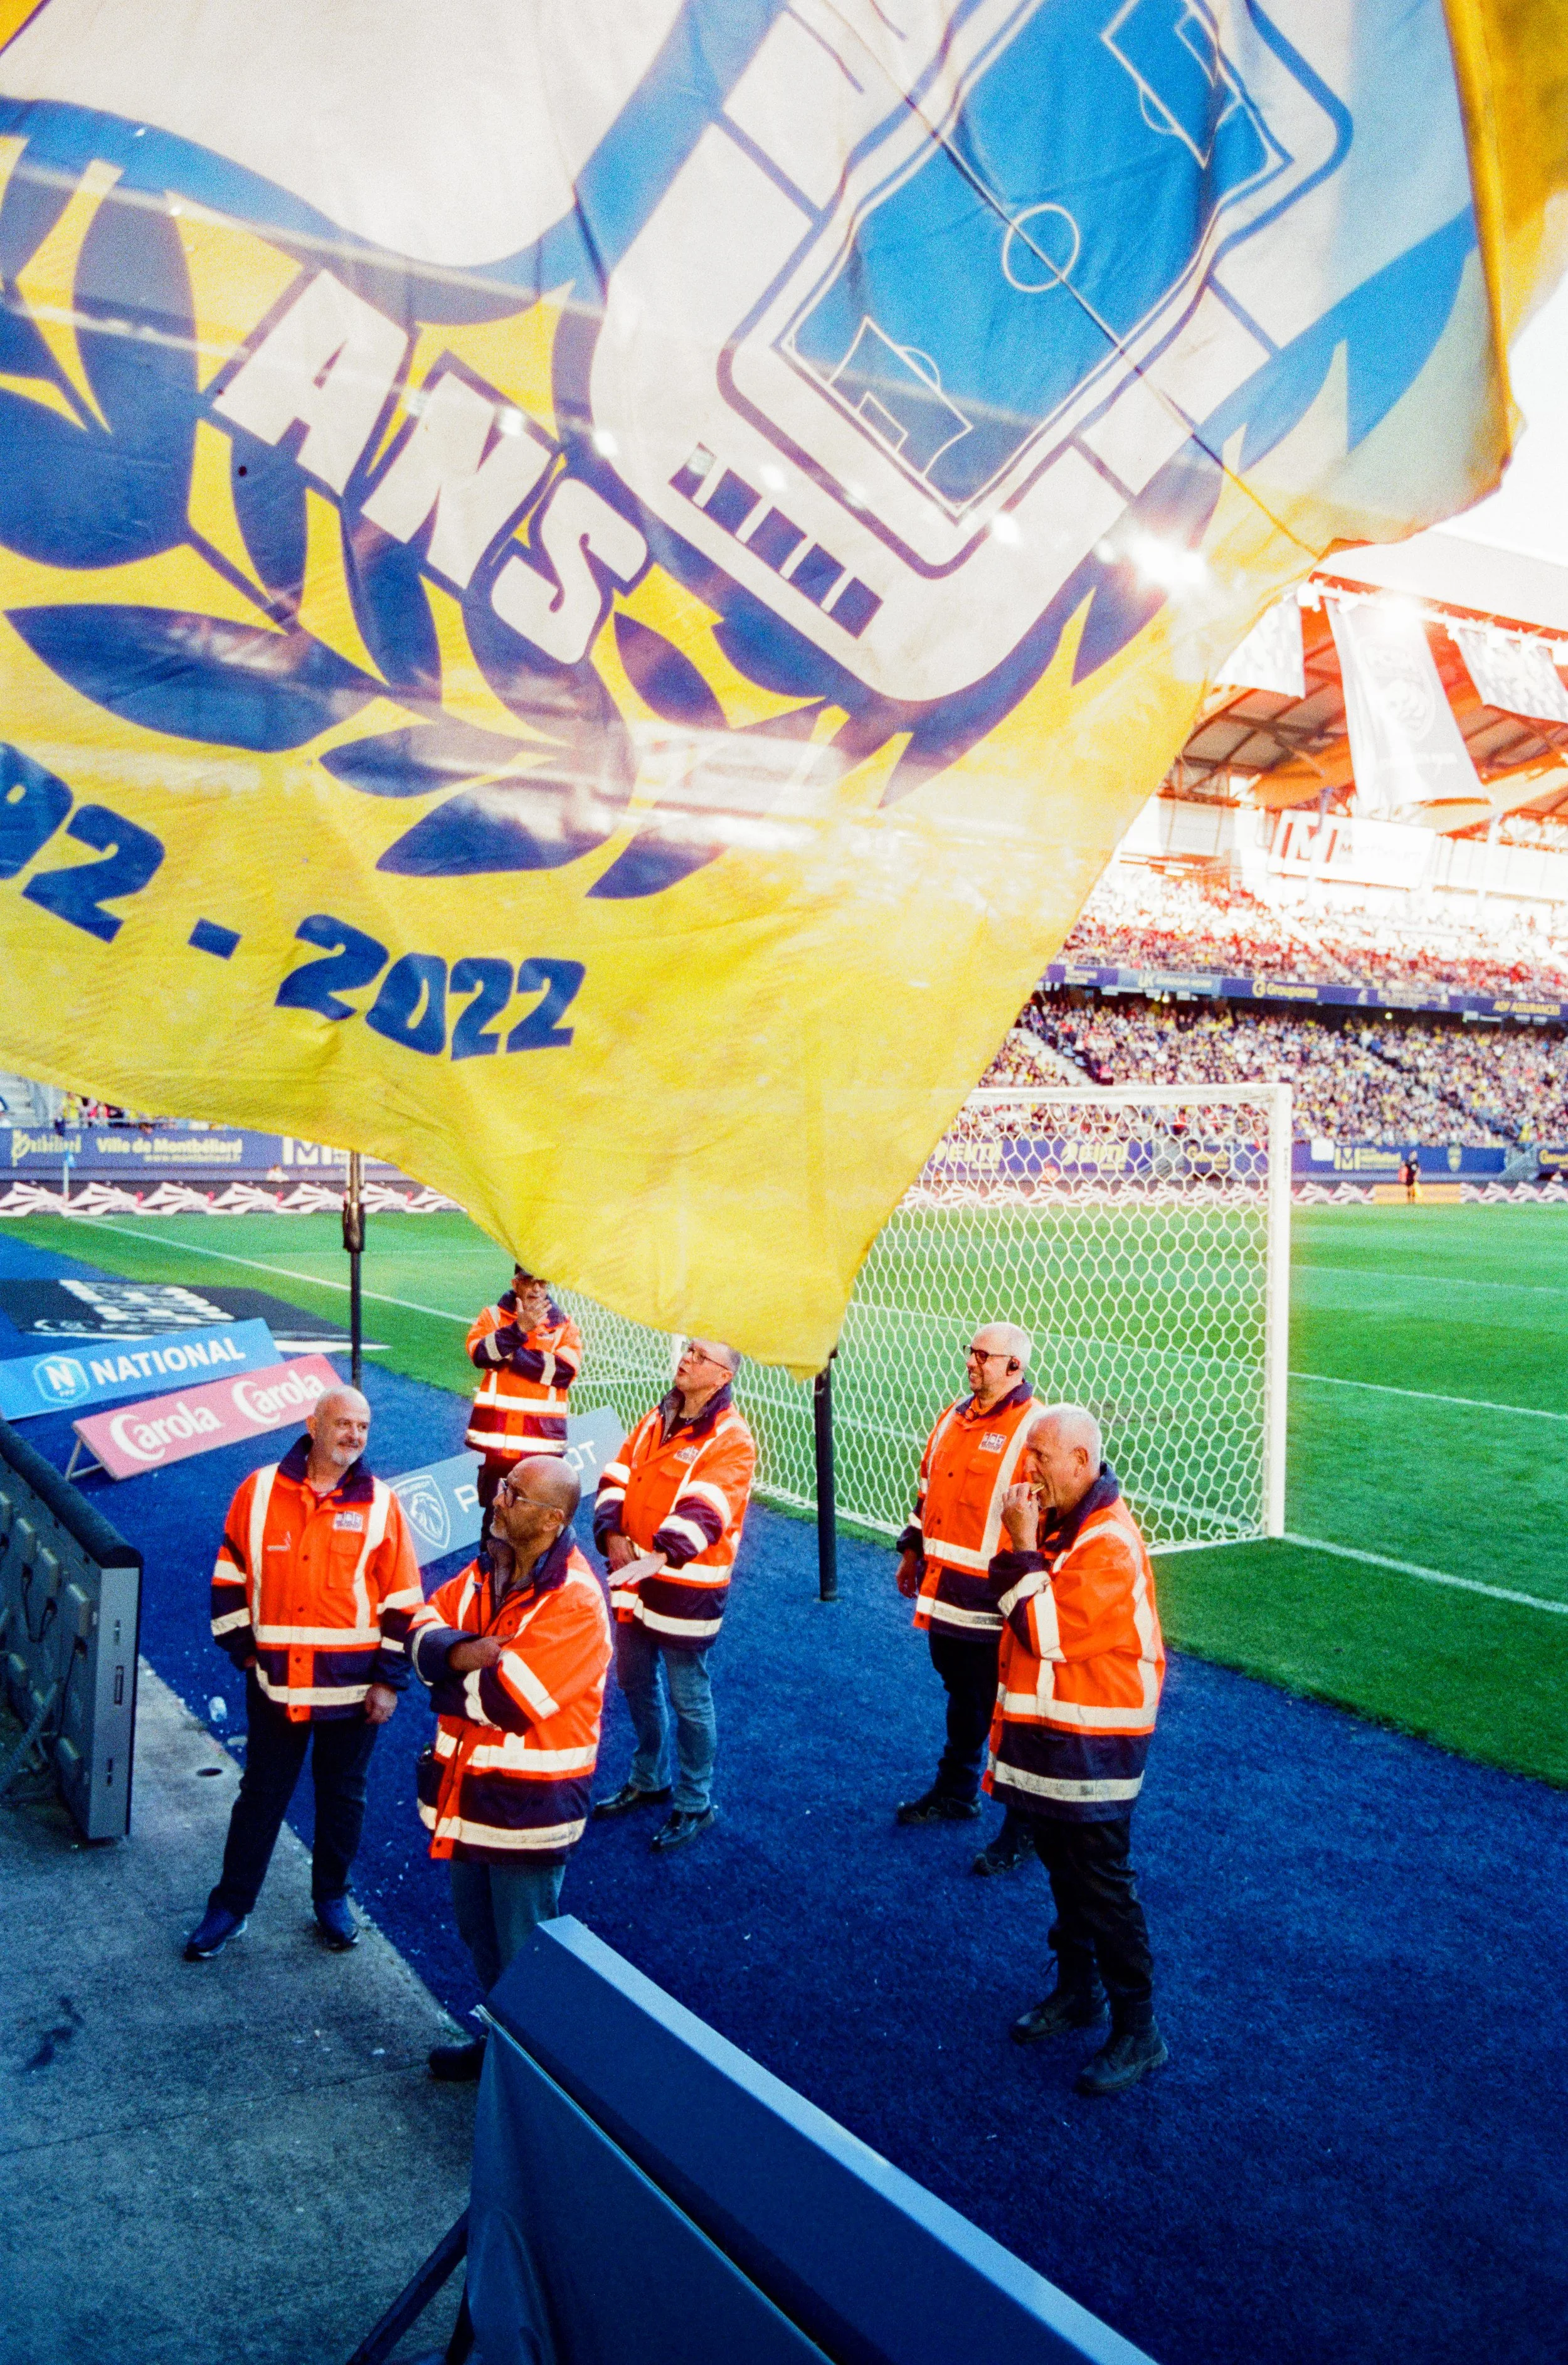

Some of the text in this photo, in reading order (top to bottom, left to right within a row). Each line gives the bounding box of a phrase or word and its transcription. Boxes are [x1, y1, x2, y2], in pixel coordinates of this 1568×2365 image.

[211, 268, 647, 664] ANS
[275, 913, 586, 1061] 2022
[97, 1137, 242, 1154] Ville de Montbéliard
[45, 1337, 246, 1391] N NATIONAL
[231, 1369, 326, 1425] Carola
[110, 1400, 225, 1462] Carola
